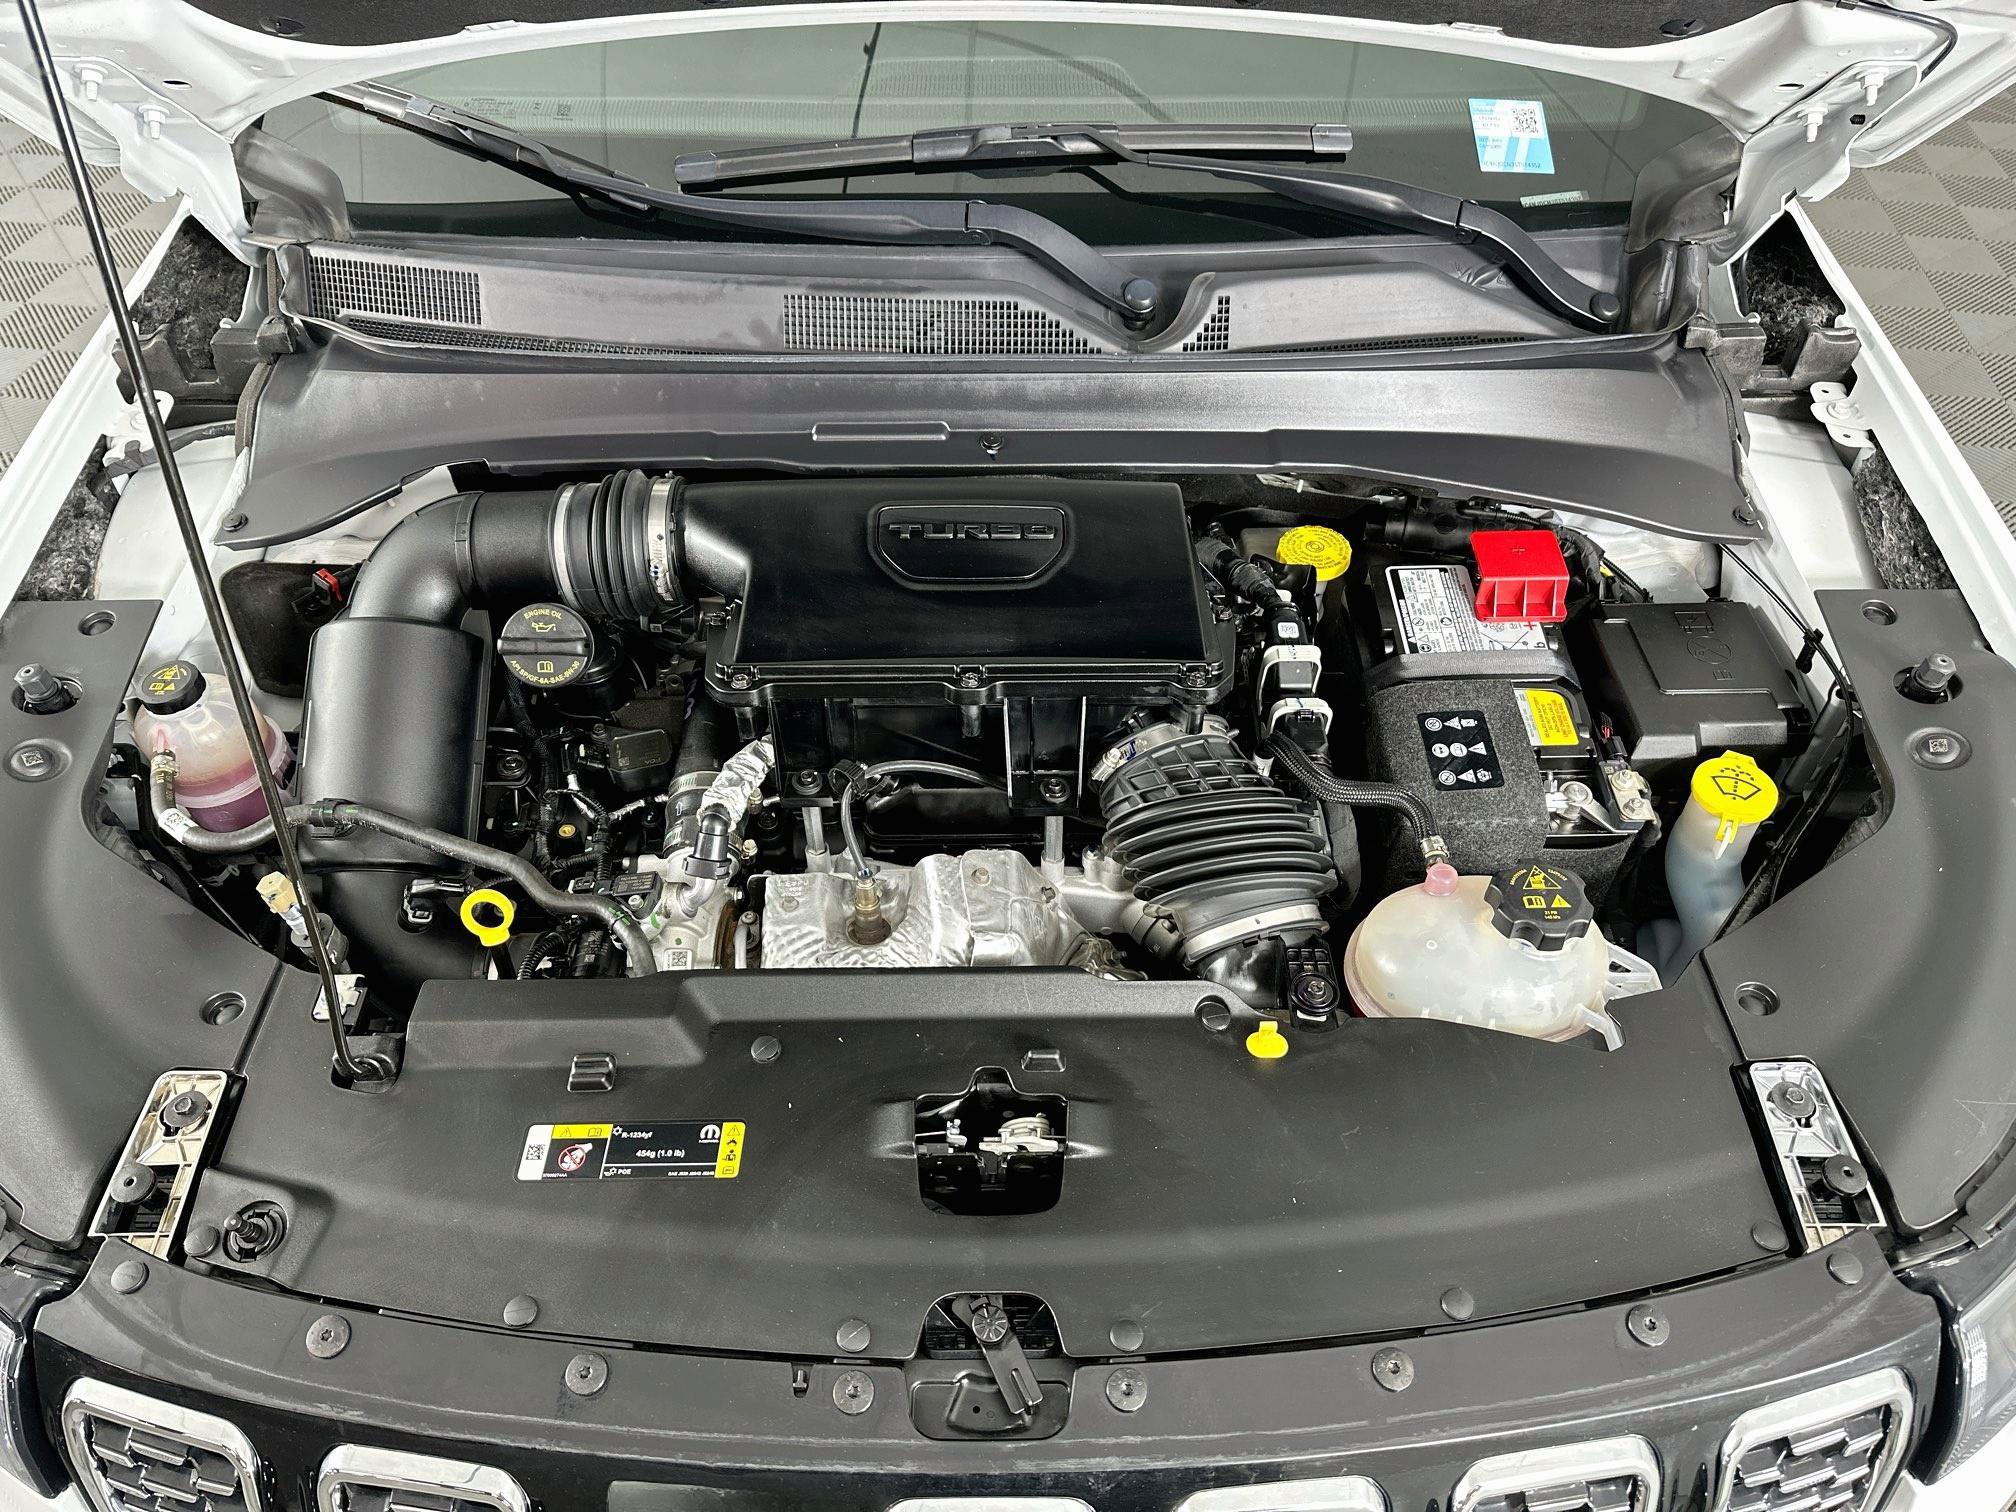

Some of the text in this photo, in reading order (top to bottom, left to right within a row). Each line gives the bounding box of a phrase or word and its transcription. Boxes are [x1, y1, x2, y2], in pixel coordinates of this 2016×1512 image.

[888, 523, 1055, 540] TURBO
[523, 608, 563, 620] ENGINE OIL
[510, 659, 522, 672] API
[621, 1130, 653, 1140] R-1234yf
[635, 1148, 686, 1160] 454g (1.0 lb)
[617, 1167, 632, 1175] POE
